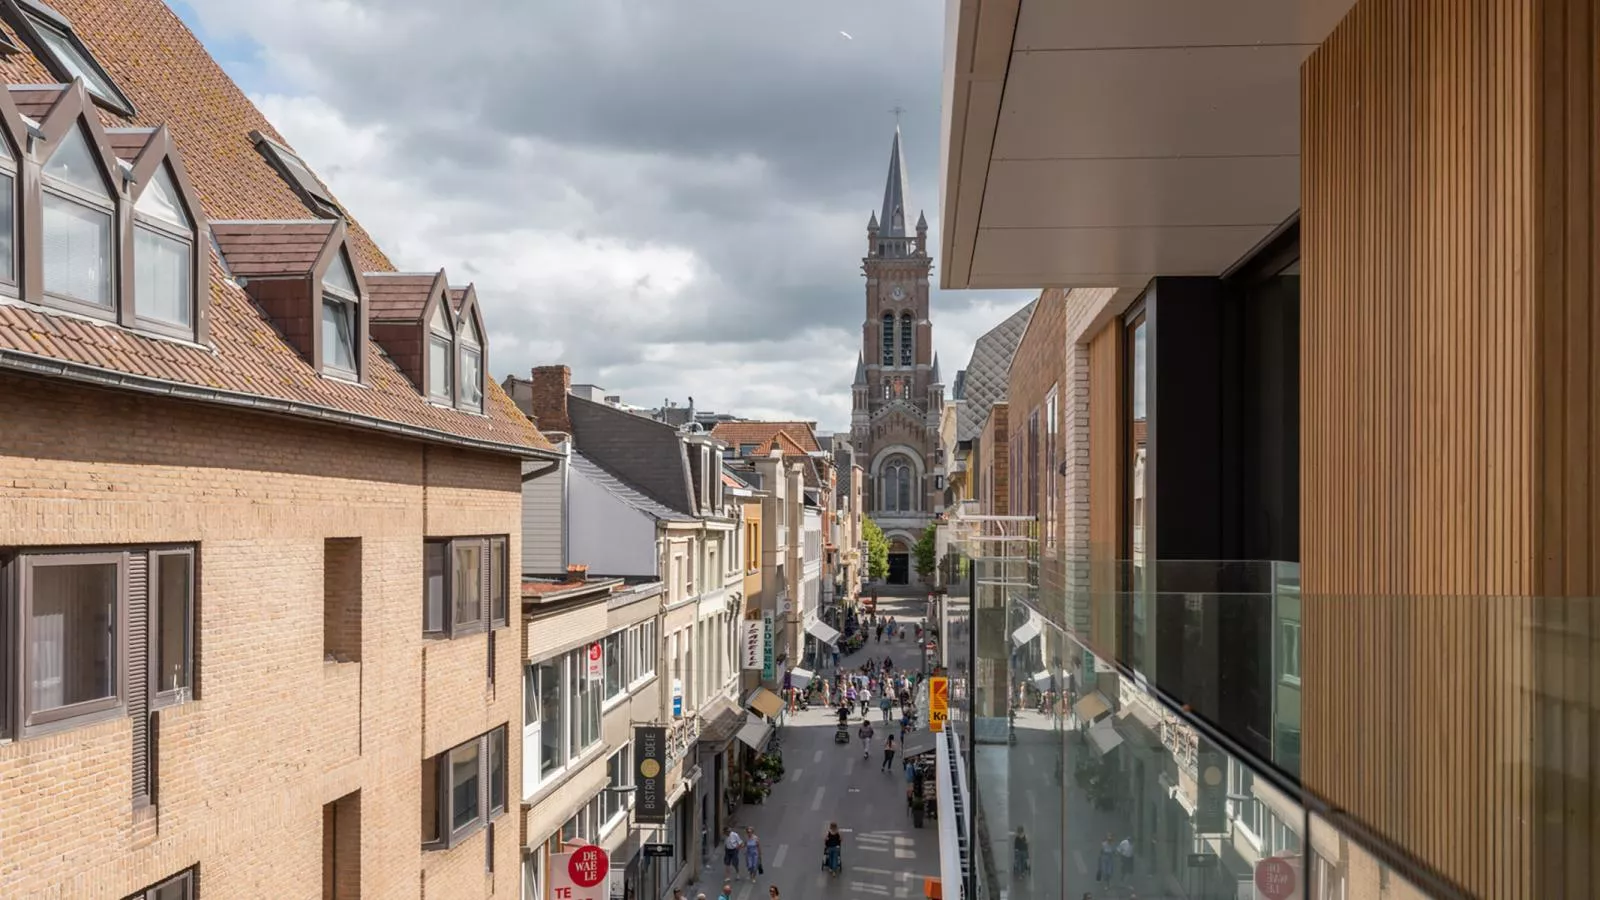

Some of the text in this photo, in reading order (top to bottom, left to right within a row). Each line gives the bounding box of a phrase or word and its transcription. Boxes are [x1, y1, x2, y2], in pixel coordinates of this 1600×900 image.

[645, 733, 656, 757] BOEIE
[645, 779, 656, 809] BISTRO
[583, 851, 597, 861] DE
[575, 861, 597, 872] WAE
[584, 871, 597, 881] LE
[554, 887, 571, 899] TE
